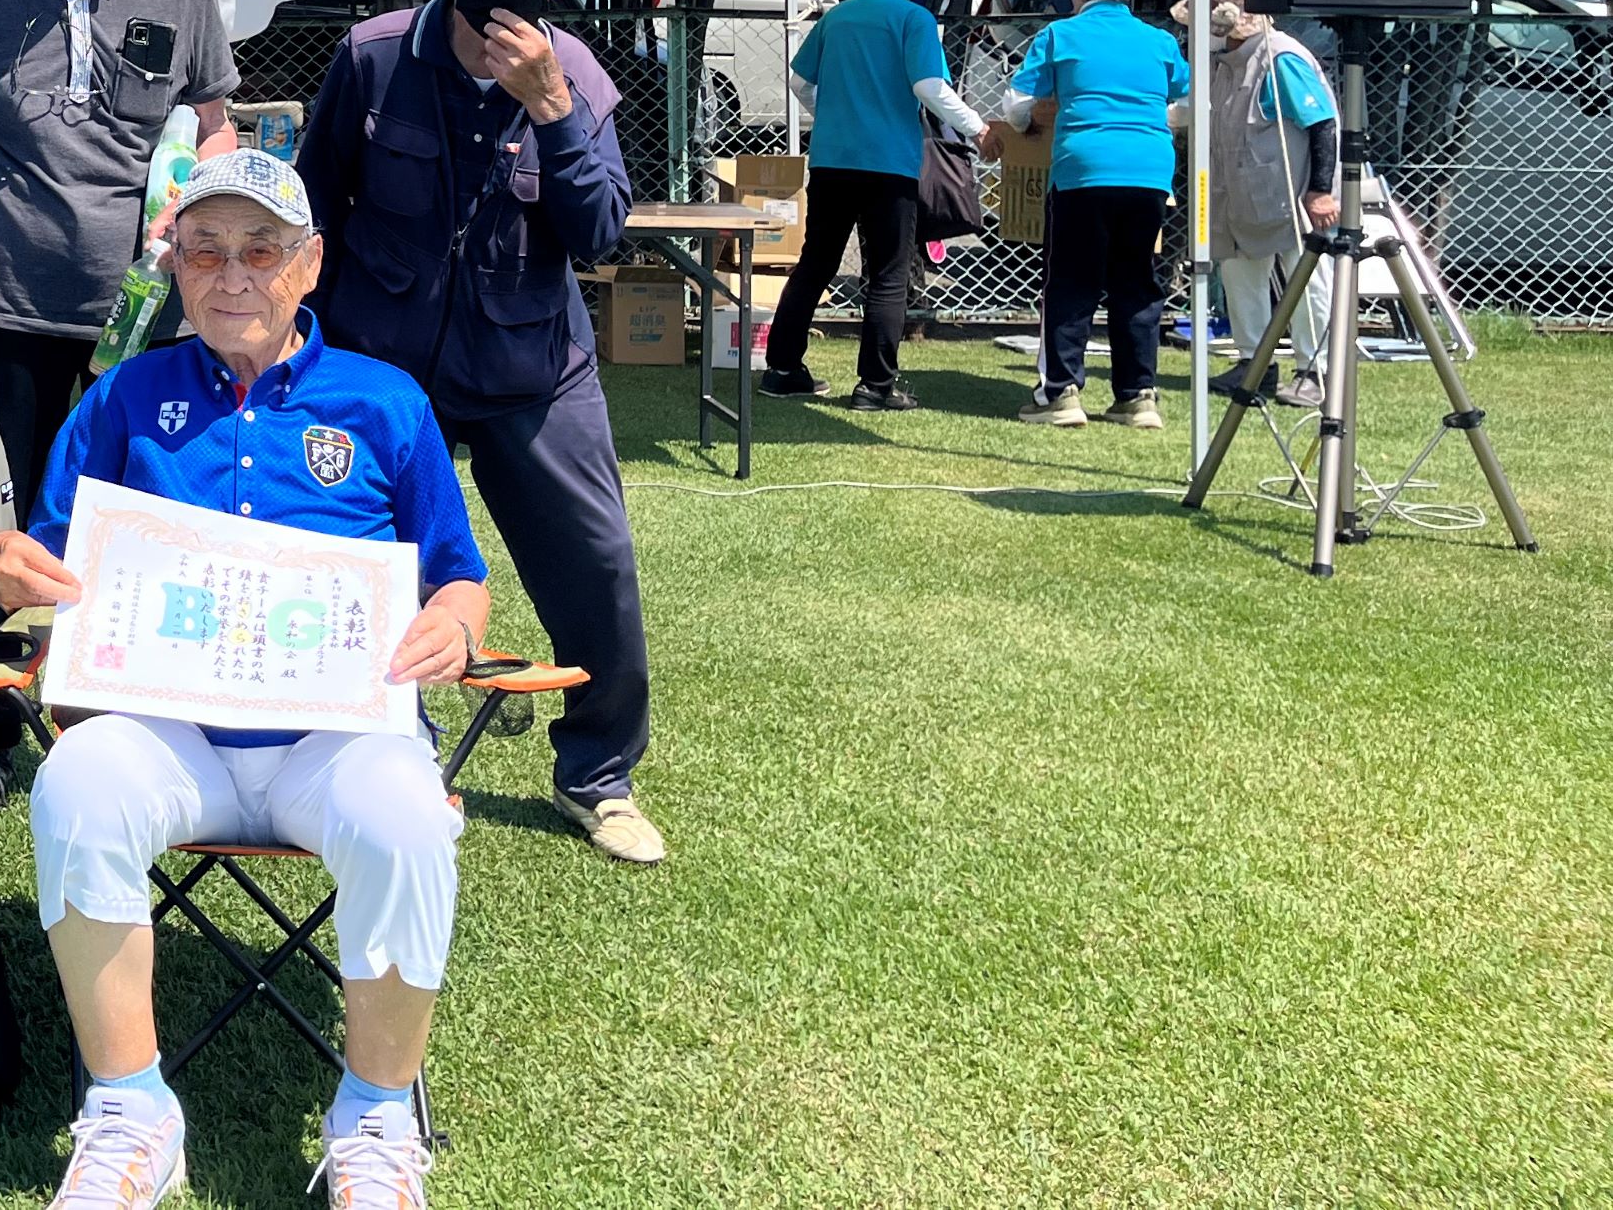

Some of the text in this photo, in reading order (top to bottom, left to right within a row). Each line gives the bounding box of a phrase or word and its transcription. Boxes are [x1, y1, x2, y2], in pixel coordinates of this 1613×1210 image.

[162, 411, 185, 420] FILA
[196, 562, 216, 650] 表彰いたします
[249, 571, 272, 684] 貴チームは頭書の成
[343, 599, 367, 651] 表彰状
